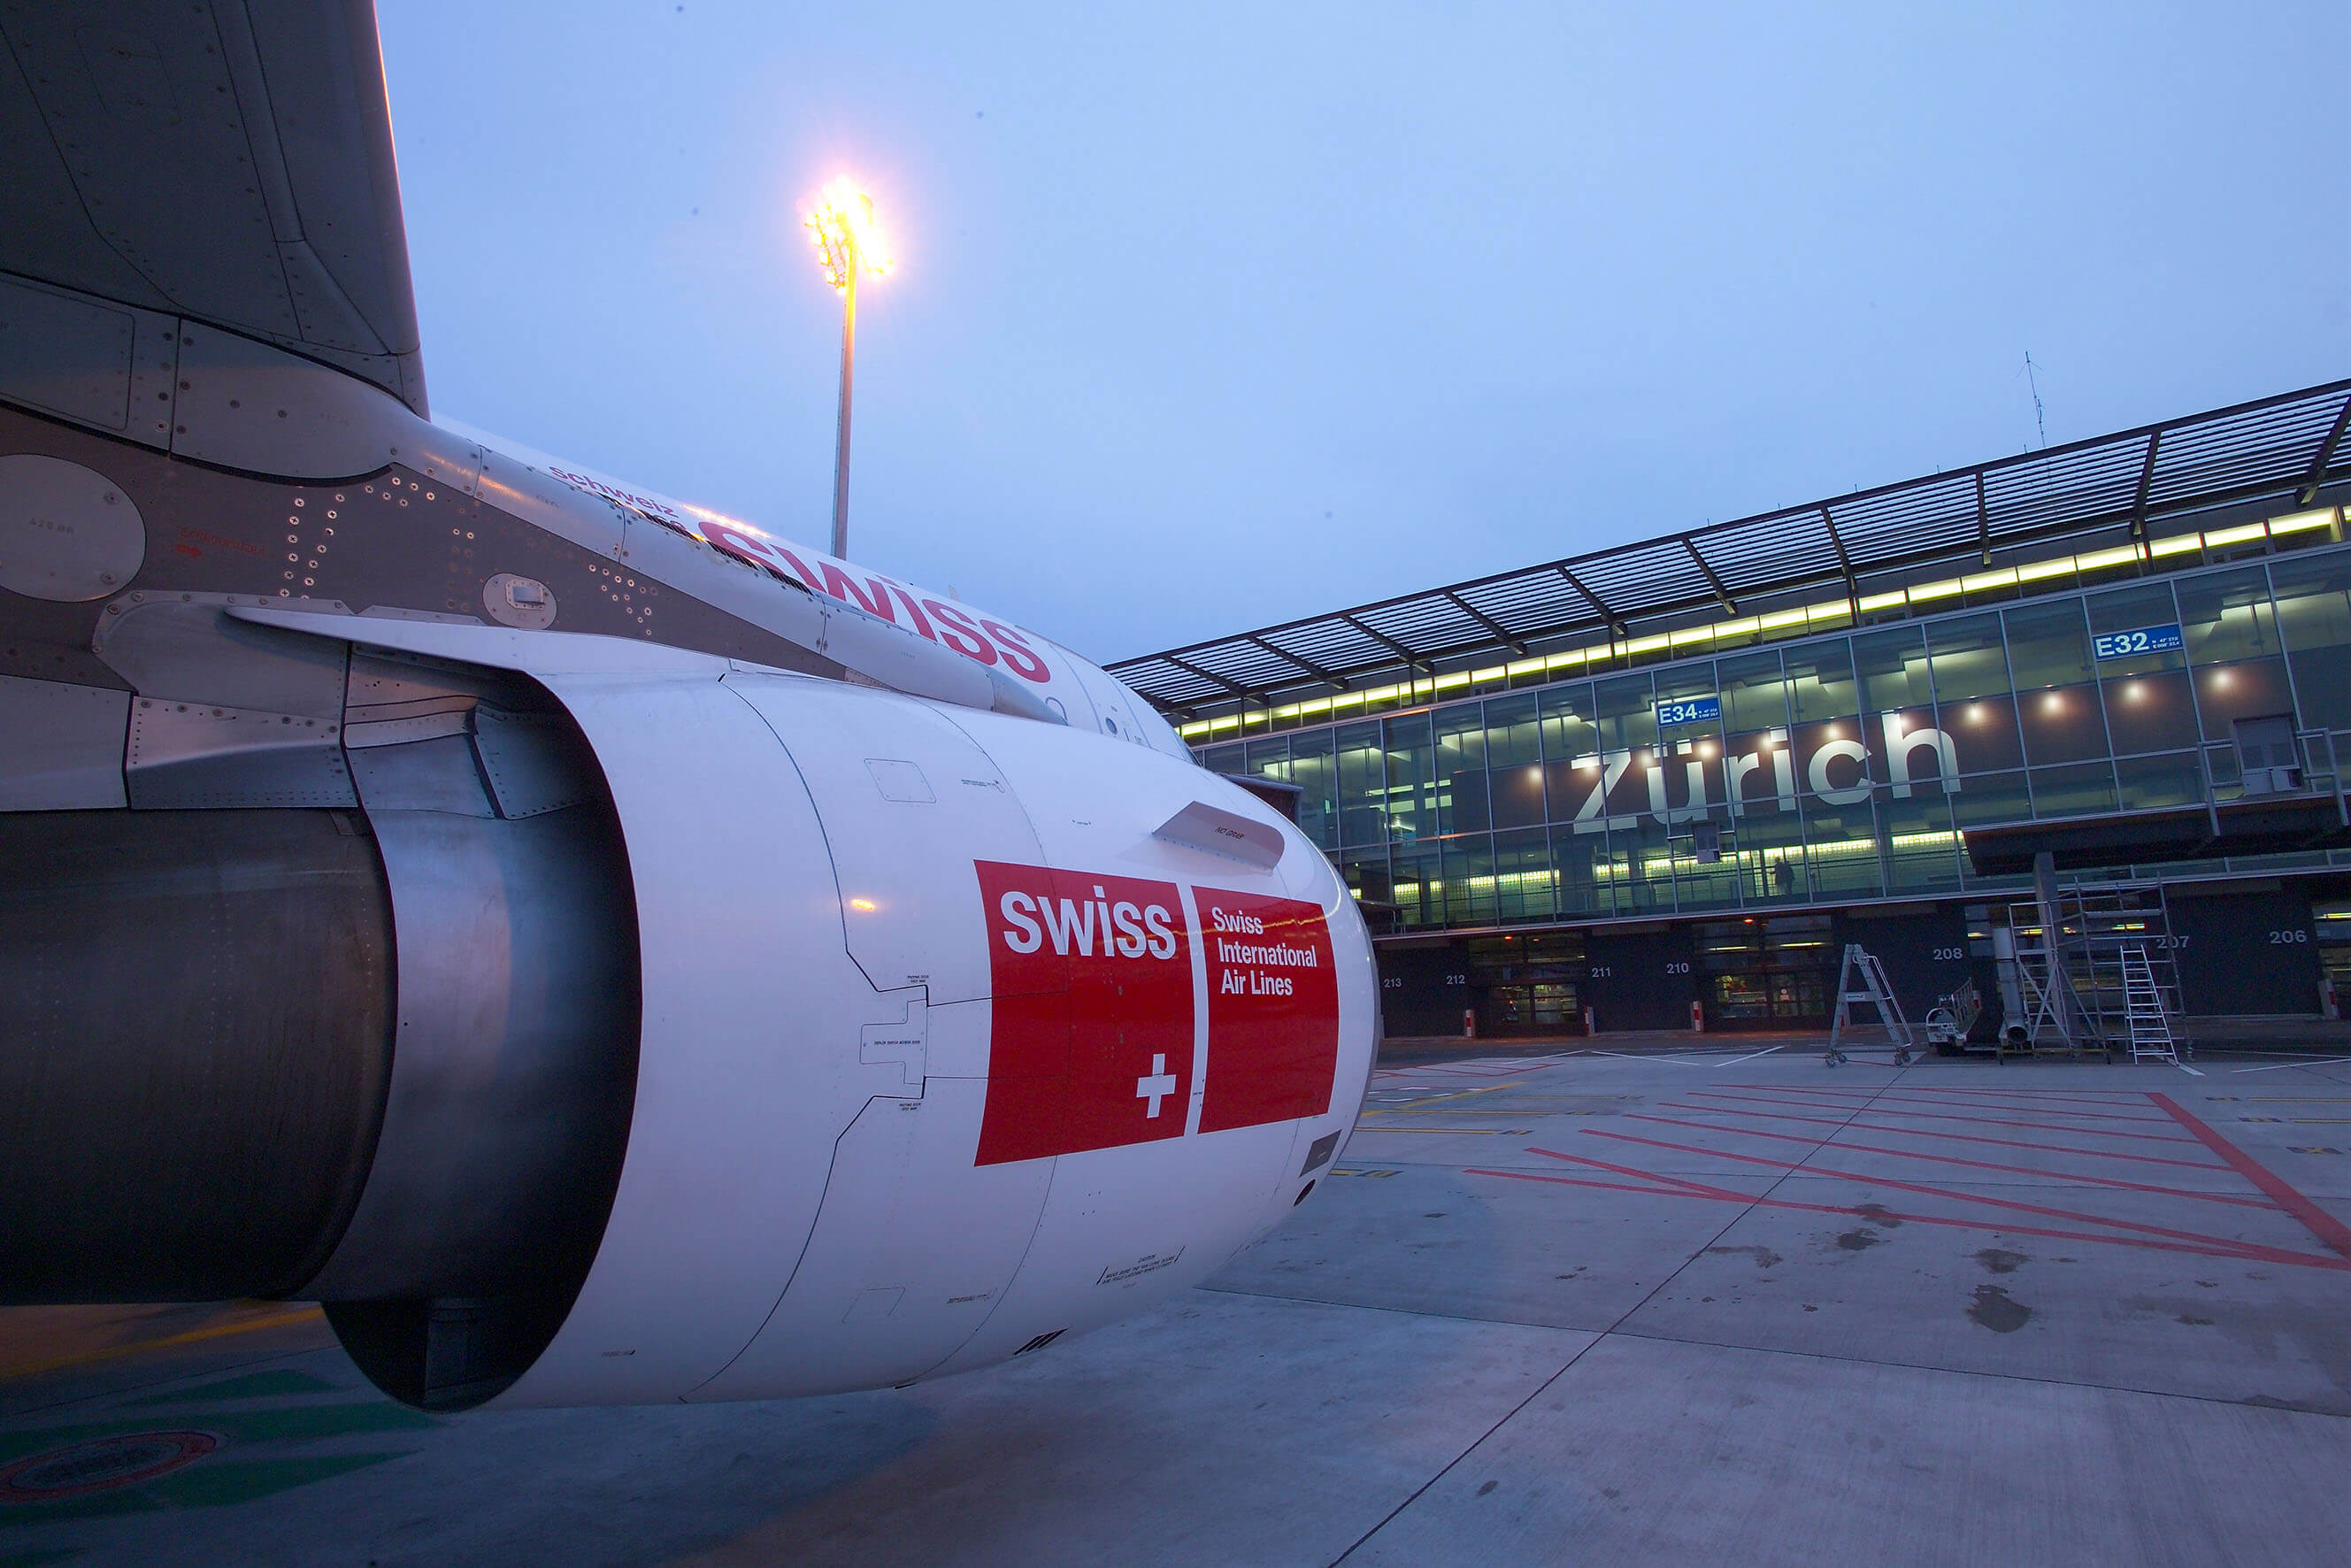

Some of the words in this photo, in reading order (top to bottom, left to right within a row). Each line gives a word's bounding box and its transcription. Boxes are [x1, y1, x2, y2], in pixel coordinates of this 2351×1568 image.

[549, 466, 679, 518] schweiz
[2095, 632, 2150, 657] E32
[1658, 703, 1698, 725] E34
[1571, 709, 1962, 834] Zürich
[1211, 906, 1264, 935] Swiss
[2156, 935, 2190, 949] 207
[2269, 929, 2308, 944] 206
[1218, 937, 1318, 968] International
[1933, 947, 1963, 961] 208
[1592, 966, 1611, 979] 211
[1666, 962, 1690, 974] 210
[1221, 969, 1245, 995] Air
[1250, 970, 1293, 996] Lines
[1384, 978, 1402, 988] 213
[1446, 974, 1466, 986] 212
